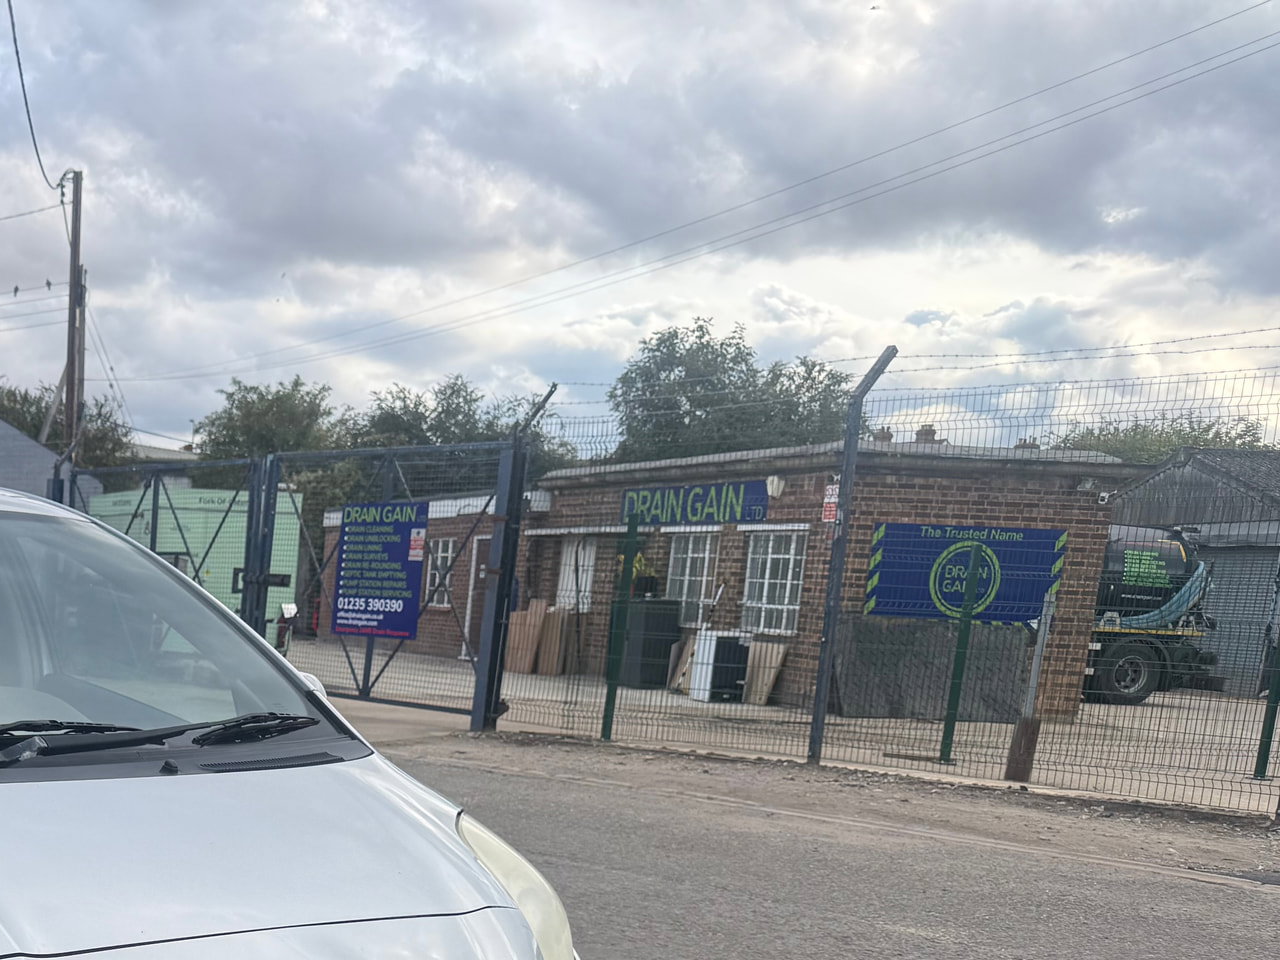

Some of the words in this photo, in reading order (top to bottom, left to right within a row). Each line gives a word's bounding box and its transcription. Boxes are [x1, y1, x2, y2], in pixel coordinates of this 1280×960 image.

[623, 488, 684, 523] DRAIN
[687, 484, 744, 522] GAIN
[745, 506, 764, 520] LTD
[344, 506, 381, 523] DRAIN
[383, 506, 417, 522] GAIN
[365, 535, 401, 543] UNBLOCKING
[920, 526, 942, 538] The
[945, 527, 988, 539] Trusted
[990, 528, 1024, 541] Name
[362, 570, 377, 578] TANK
[378, 571, 407, 579] EMPTYING
[945, 565, 988, 579] DRN
[357, 588, 381, 596] STATION
[337, 597, 366, 610] 01235
[367, 598, 404, 612] 390390
